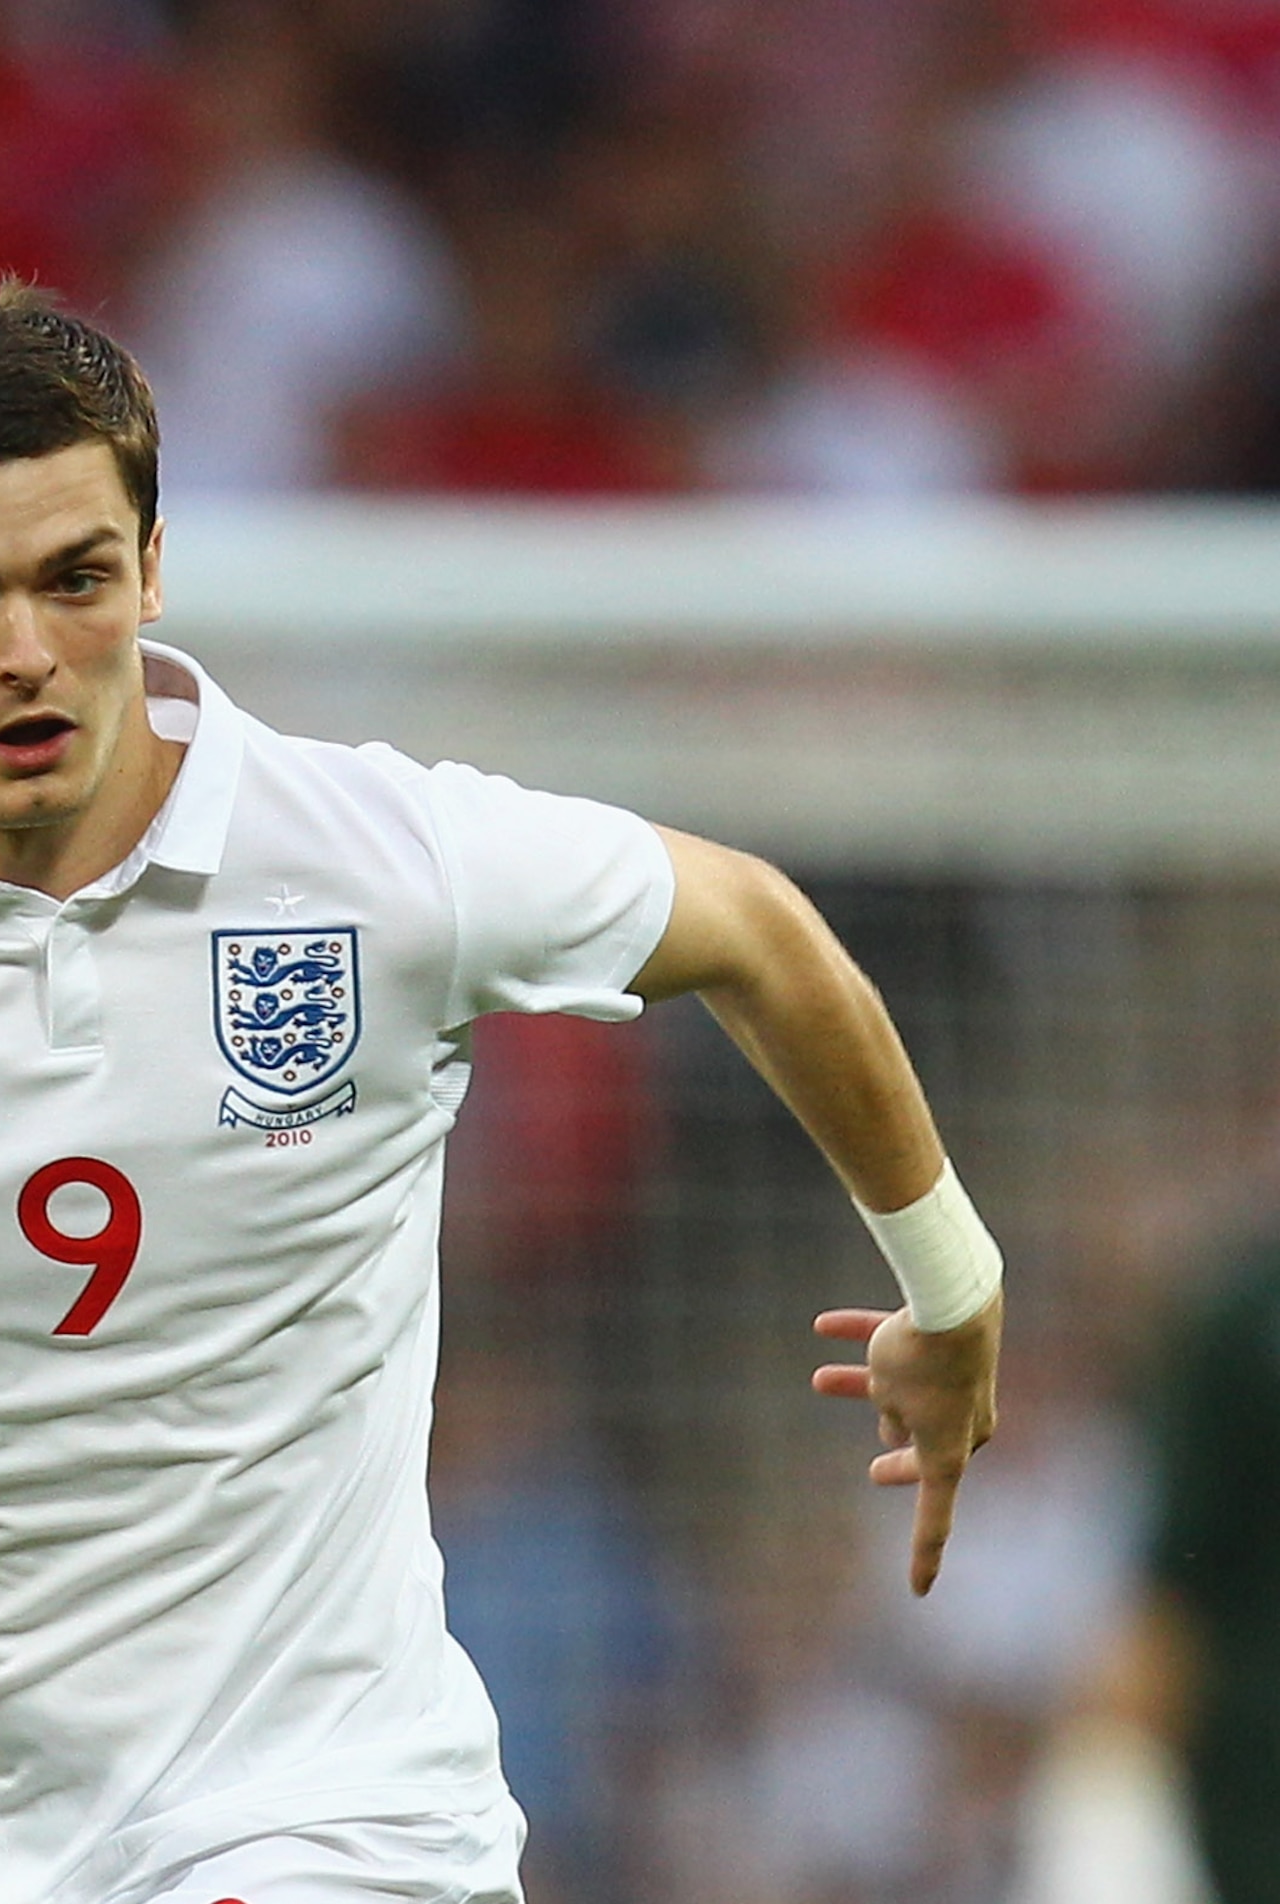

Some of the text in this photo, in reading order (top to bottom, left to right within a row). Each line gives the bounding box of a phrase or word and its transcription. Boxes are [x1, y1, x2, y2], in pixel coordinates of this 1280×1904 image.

[254, 1105, 324, 1127] HUNGARY
[265, 1129, 312, 1147] 2010
[17, 1156, 142, 1335] 9
